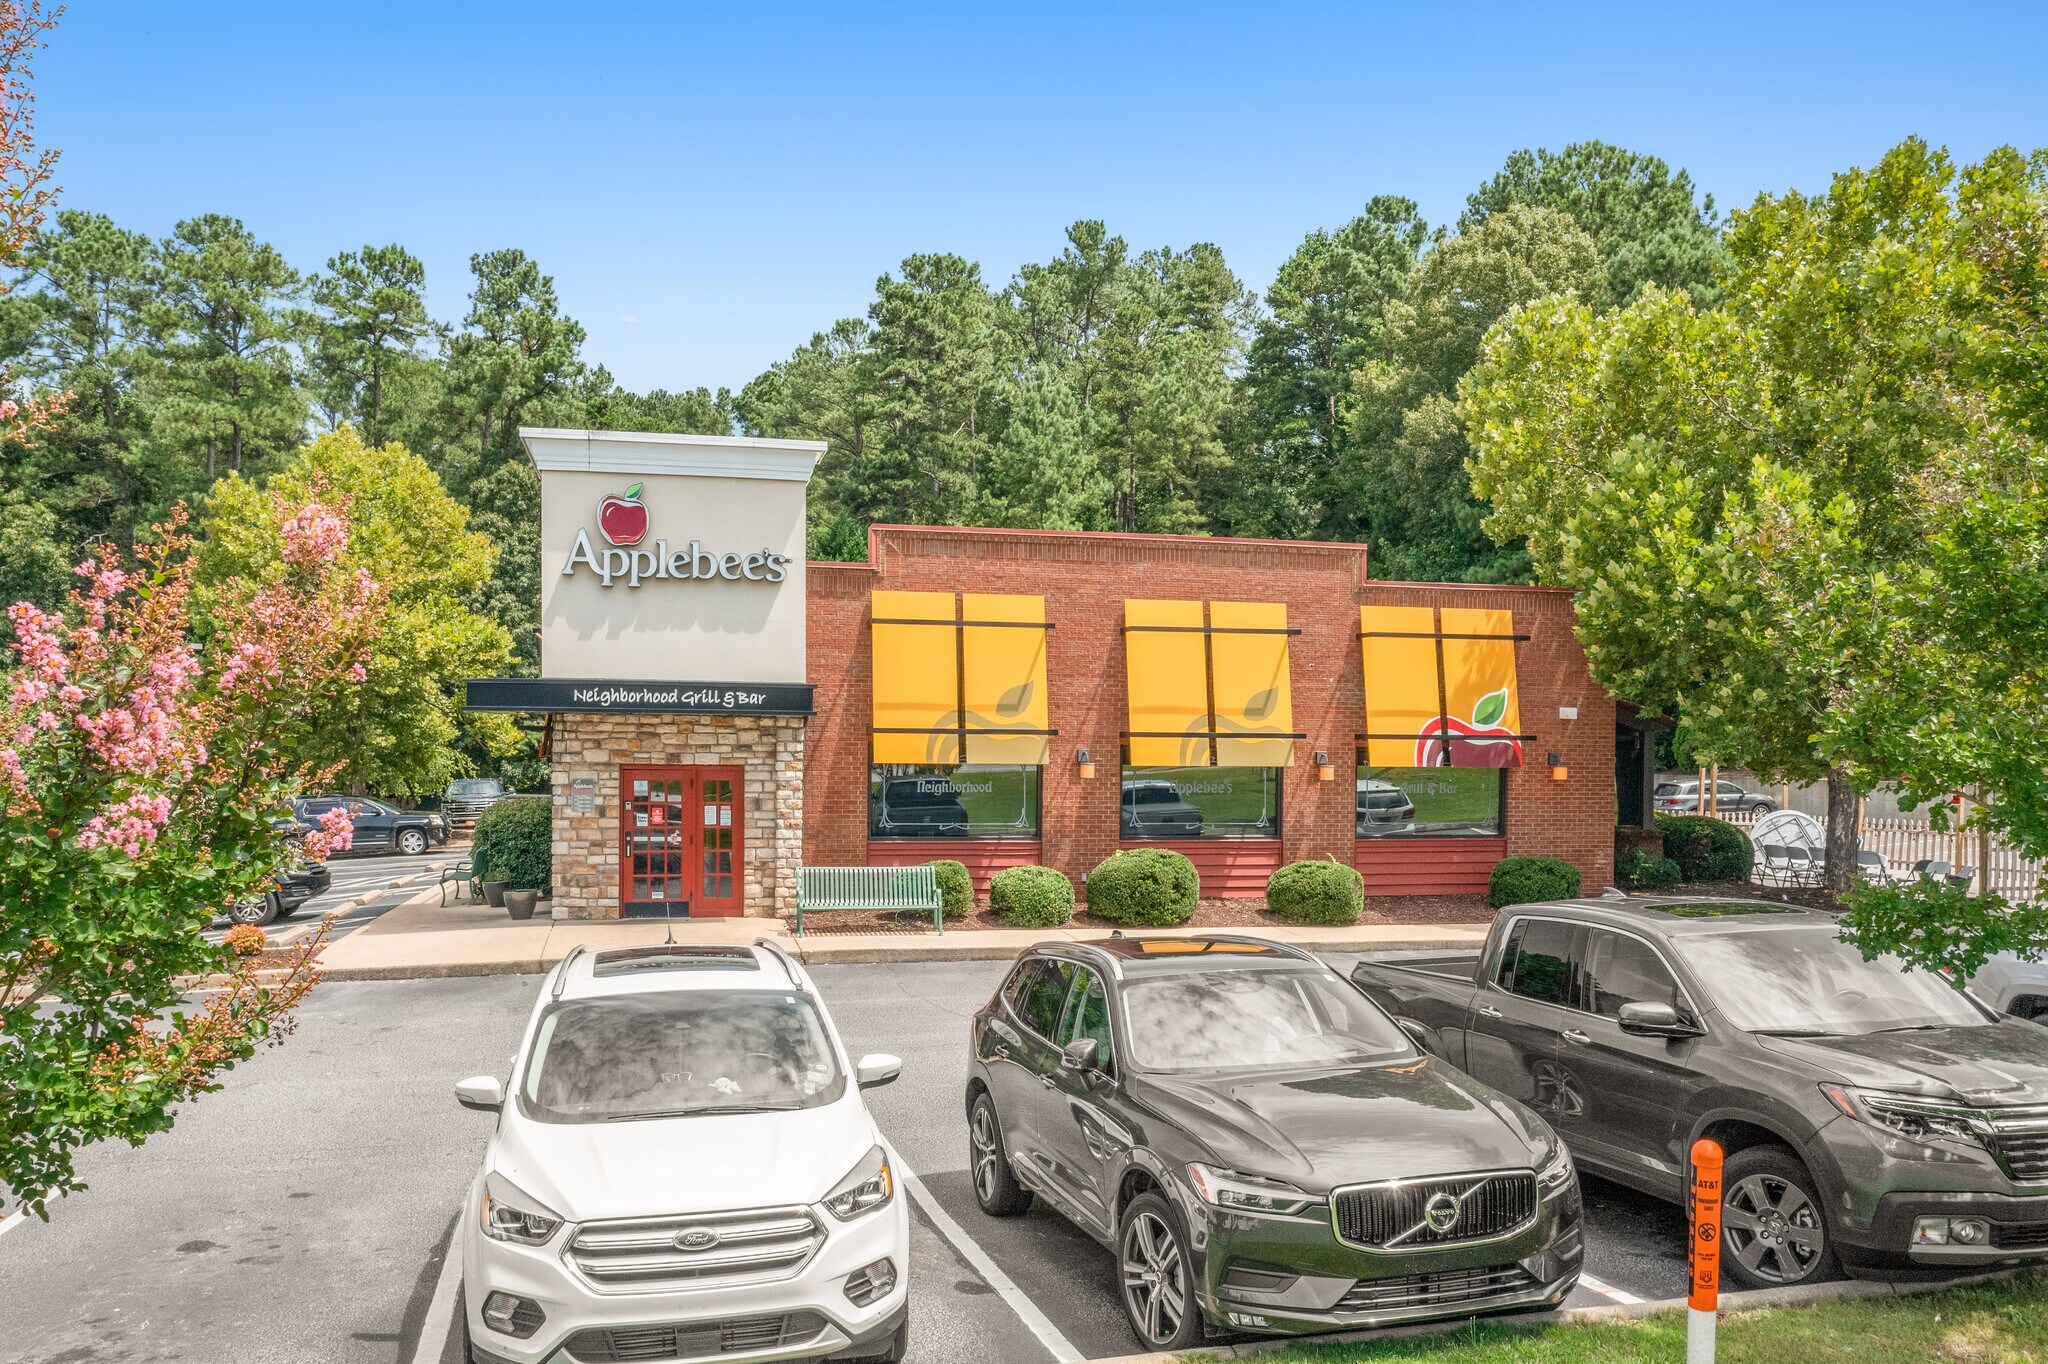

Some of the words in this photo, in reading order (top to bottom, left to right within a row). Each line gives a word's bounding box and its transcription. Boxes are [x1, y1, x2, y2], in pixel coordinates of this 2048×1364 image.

[562, 528, 792, 587] Applebee's
[574, 688, 678, 706] Neighborhood
[681, 691, 721, 706] Grill
[723, 691, 735, 708] &
[736, 691, 766, 704] Bar
[917, 780, 992, 795] Neighborhood
[1439, 783, 1457, 794] Bar
[1698, 1180, 1718, 1189] AT&T
[685, 1233, 709, 1245] Ford
